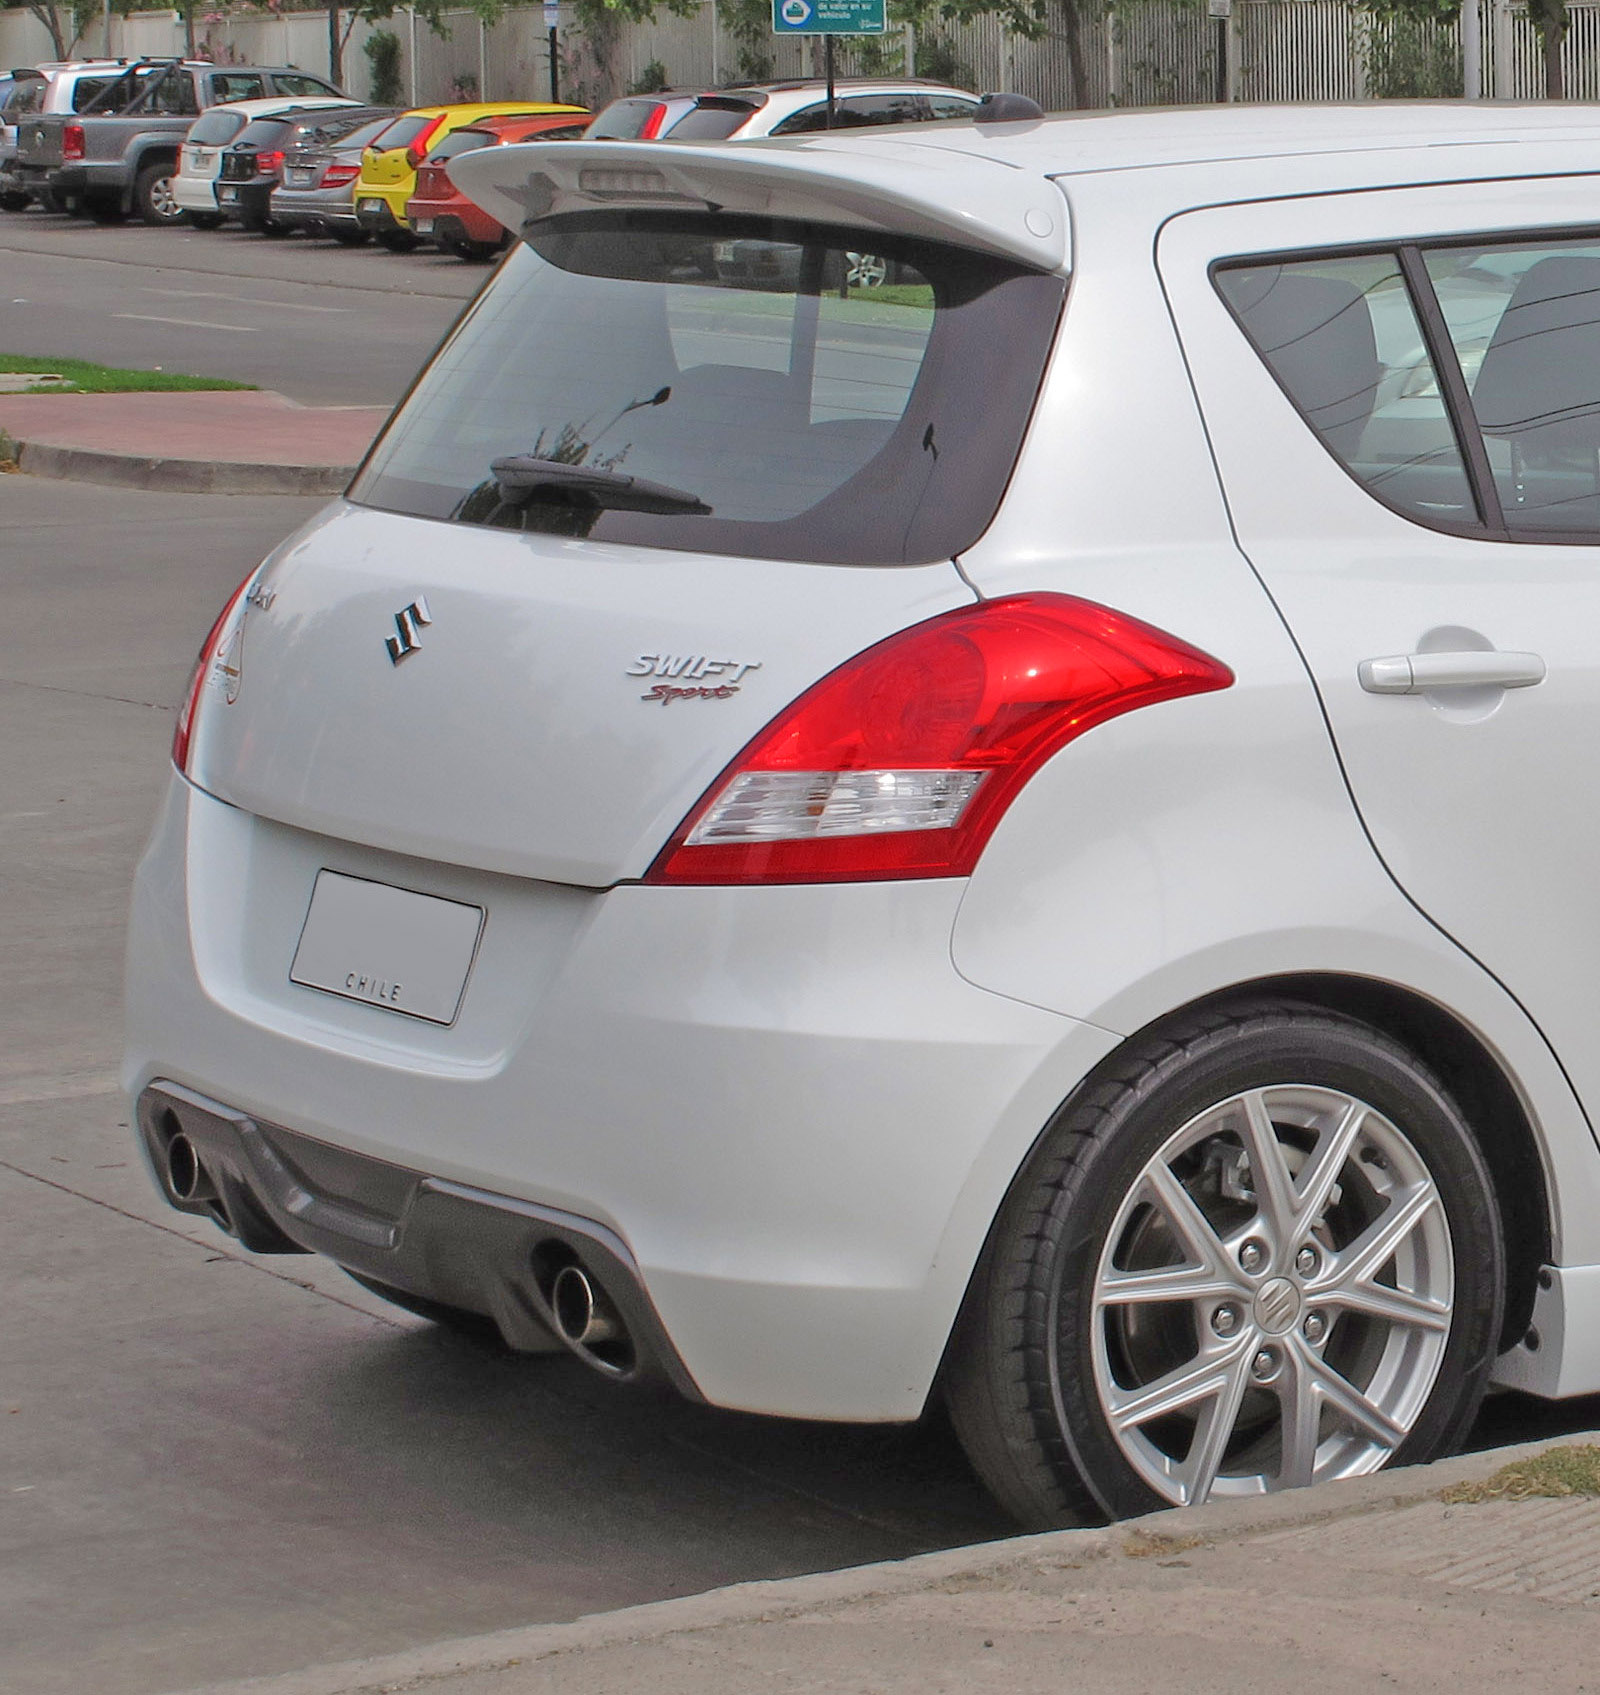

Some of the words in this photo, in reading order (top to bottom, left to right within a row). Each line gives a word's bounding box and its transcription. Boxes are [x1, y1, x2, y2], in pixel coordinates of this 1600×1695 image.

[625, 654, 763, 683] SWIFT
[641, 682, 741, 706] Sport
[345, 972, 402, 1001] CHILE
